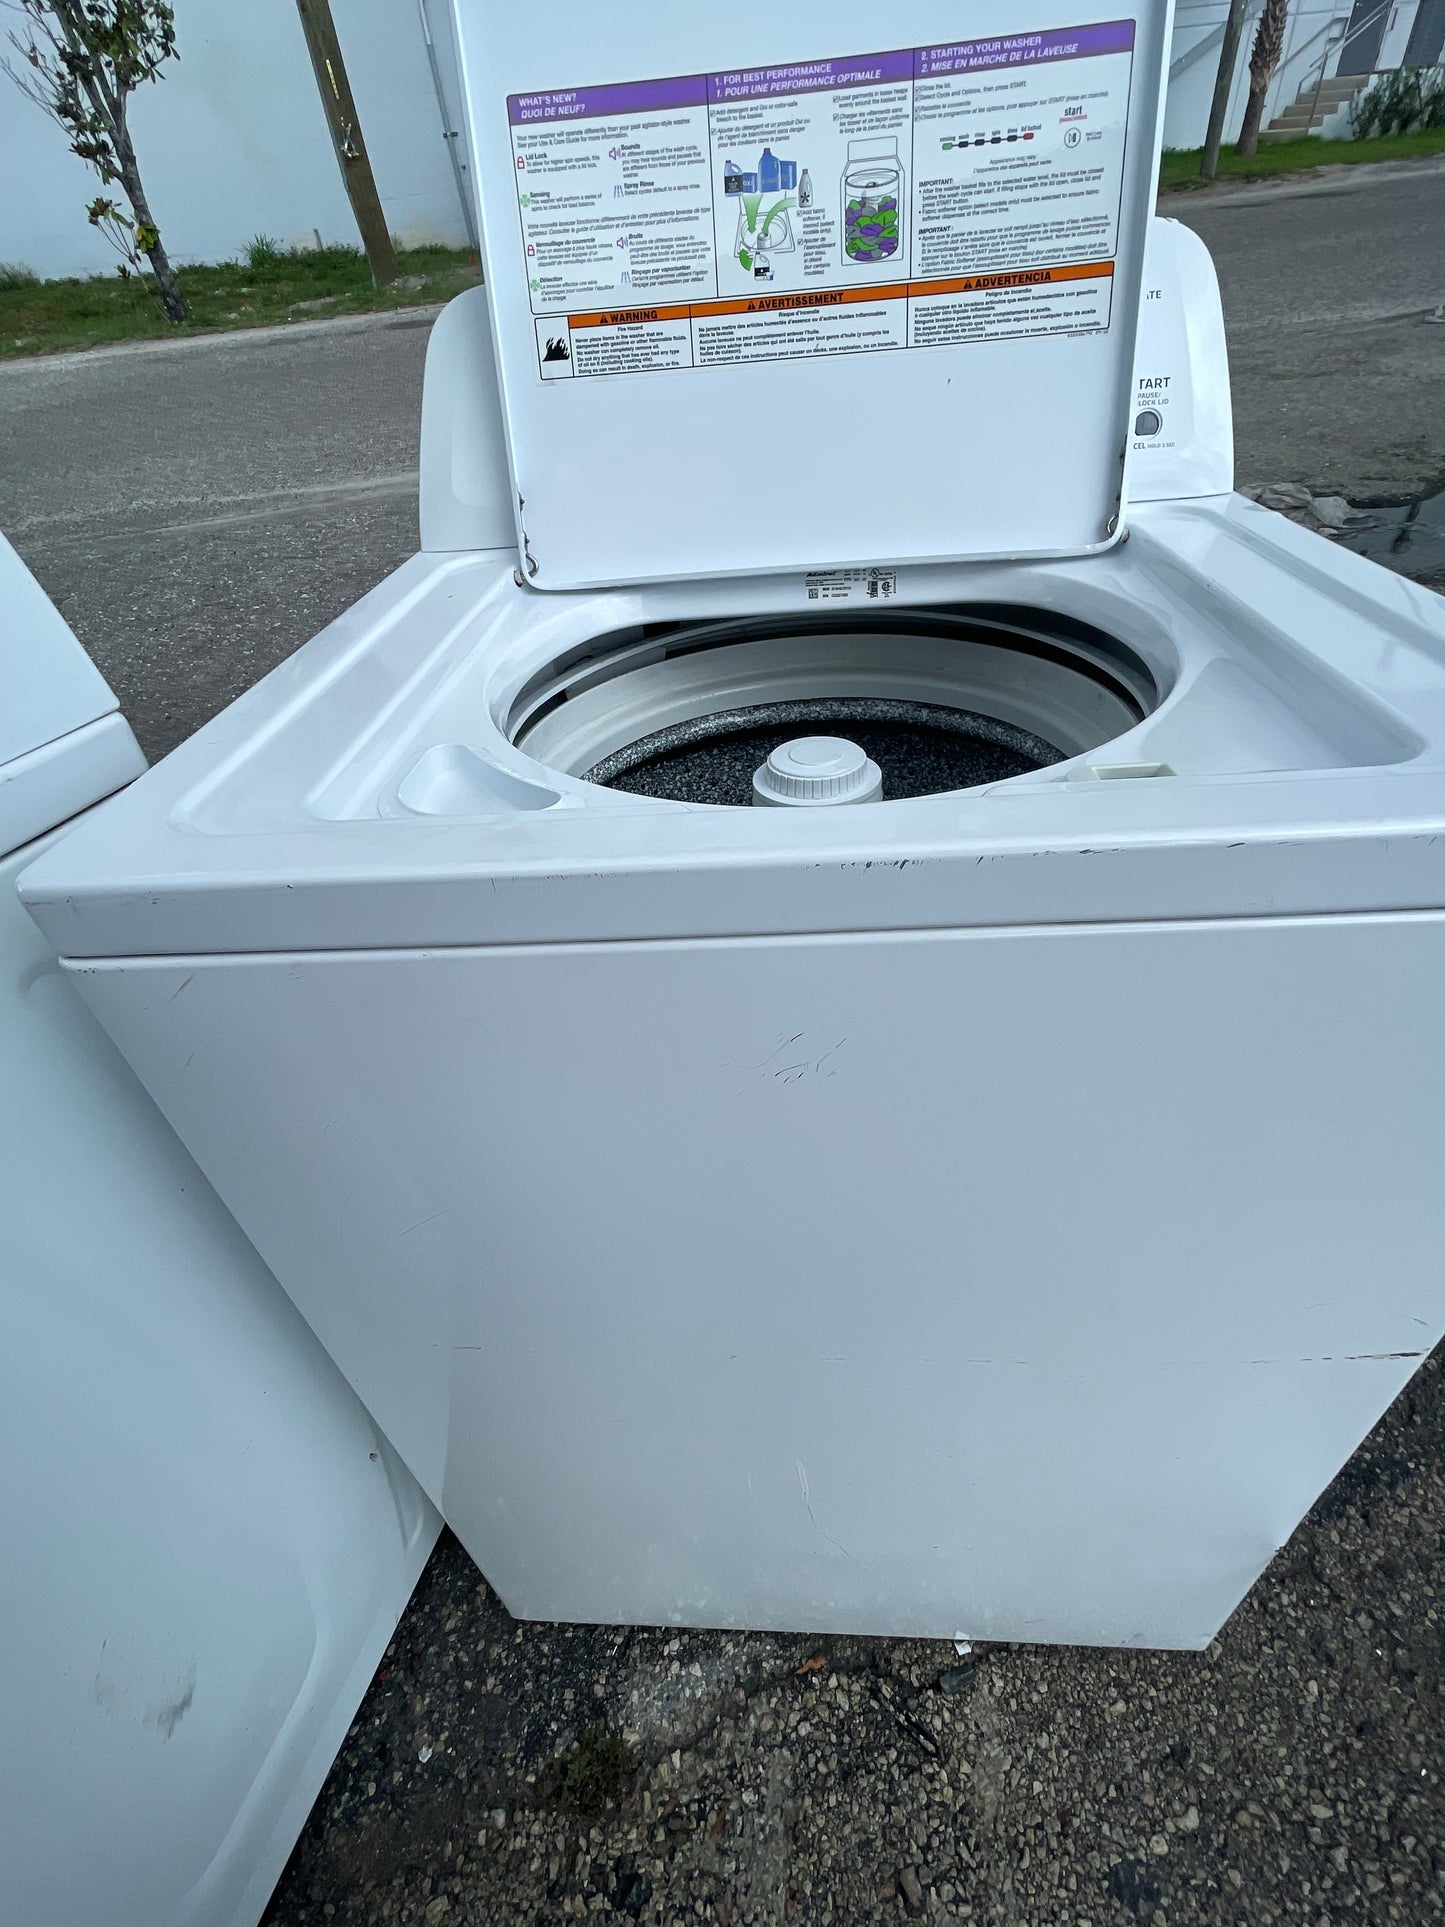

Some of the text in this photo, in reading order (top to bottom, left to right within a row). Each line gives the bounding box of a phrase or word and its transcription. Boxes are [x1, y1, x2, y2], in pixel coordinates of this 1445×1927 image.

[921, 36, 1042, 60] 2. STARTING YOUR WASHER
[921, 44, 1079, 72] 2. MISE EN MARCHE DE LA LAVEUSE
[715, 64, 832, 86] 1. FOR BEST PERFORMANCE
[717, 70, 882, 98] 1. POUR UNE PERFORMANCE OPTIMALE
[518, 93, 577, 107] WHAT'S NEW?
[521, 104, 585, 119] QUOI DE NEUF?
[1064, 106, 1082, 116] start
[940, 135, 956, 143] sensing
[621, 143, 641, 151] Sounds
[624, 182, 639, 190] Spray
[530, 191, 550, 199] Sensing
[536, 239, 564, 249] Verrouillage
[572, 236, 595, 244] couvercle
[540, 275, 563, 283] Détection
[975, 271, 1051, 288] ADVERTENCIA
[985, 290, 1002, 298] Peligro
[1147, 290, 1162, 299] TE
[759, 292, 844, 309] AVERTISSEMENT
[610, 310, 658, 323] WARNING
[610, 346, 634, 354] completely
[601, 359, 623, 367] (including
